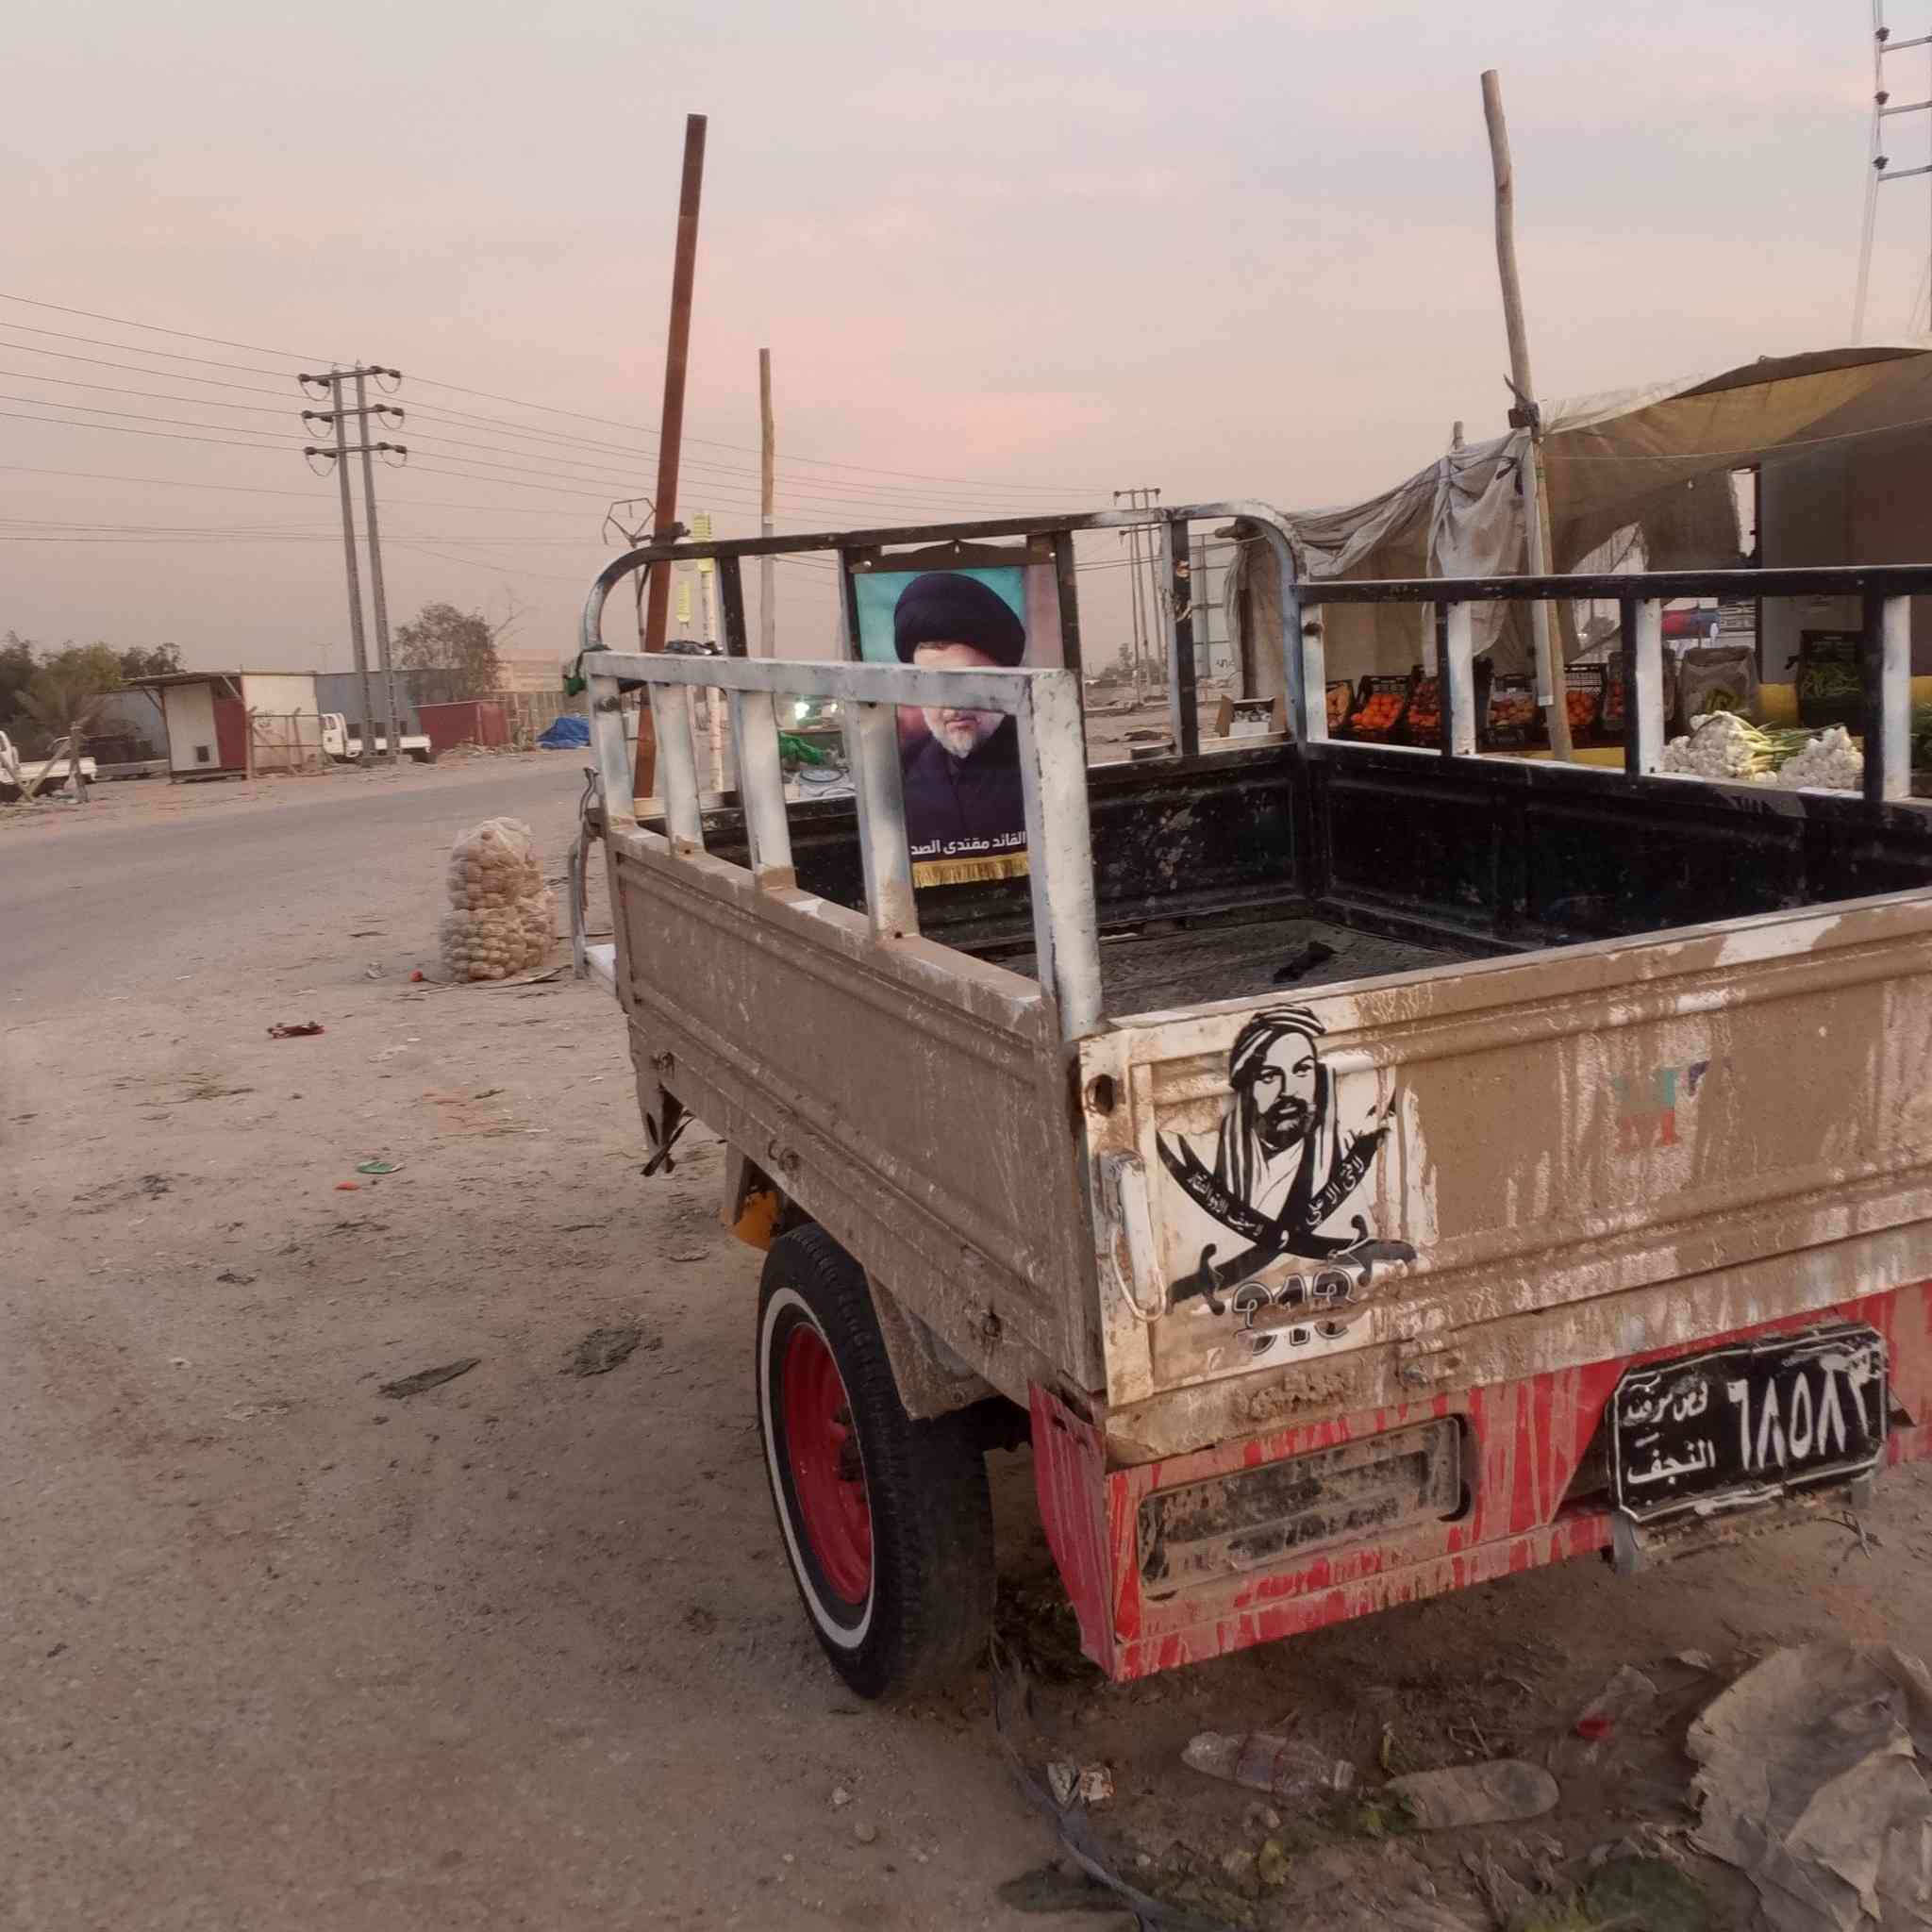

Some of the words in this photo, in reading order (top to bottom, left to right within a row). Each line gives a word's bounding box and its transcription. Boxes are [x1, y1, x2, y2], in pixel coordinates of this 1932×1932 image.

[943, 839, 990, 855] مقتدى
[991, 831, 1026, 848] القائد
[910, 840, 941, 856] الصد
[1627, 1436, 1716, 1485] النجف
